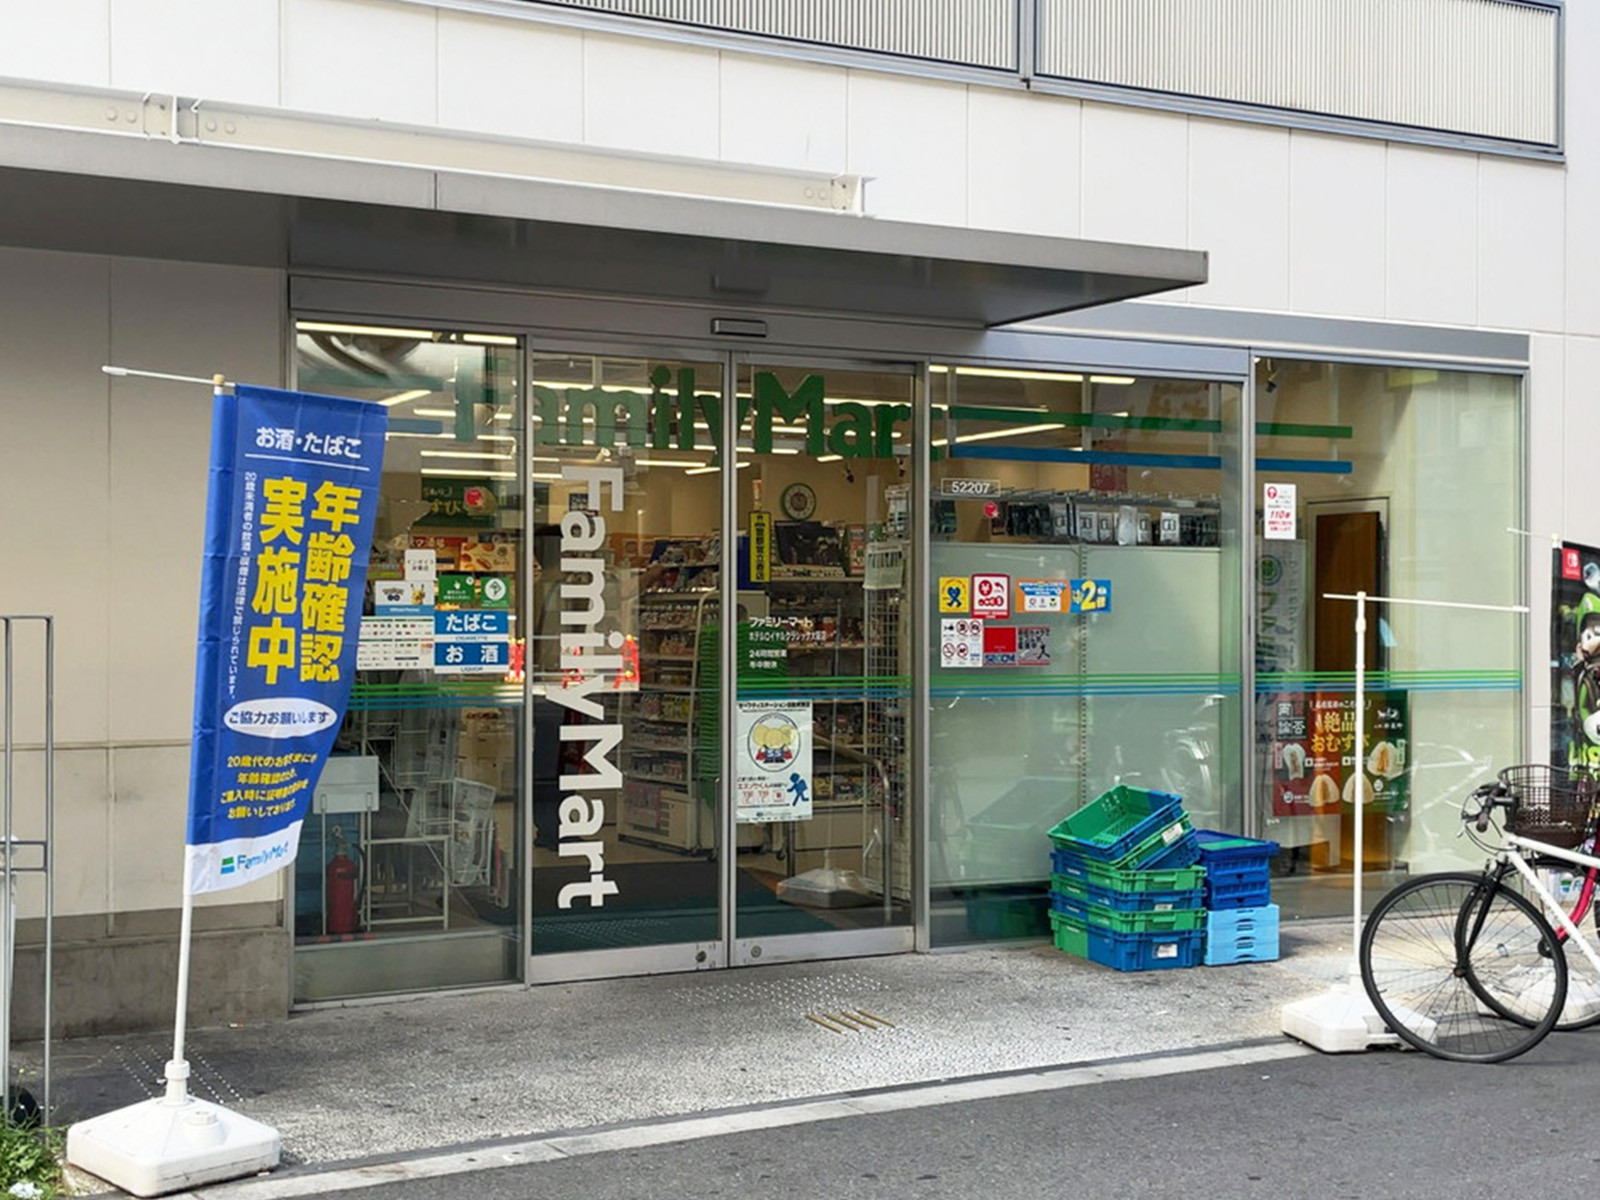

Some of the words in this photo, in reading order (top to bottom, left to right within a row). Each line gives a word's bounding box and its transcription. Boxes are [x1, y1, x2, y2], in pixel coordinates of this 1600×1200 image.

[256, 427, 362, 459] お酒・たばこ
[951, 481, 990, 494] 52207
[246, 476, 307, 685] 実施中
[300, 481, 362, 683] 年齢確認
[446, 613, 498, 632] たばこ
[749, 616, 814, 628] ファミリーマート
[546, 465, 625, 909] FamilyMart
[229, 711, 330, 725] ご協力お願いします
[1311, 733, 1370, 752] おむす
